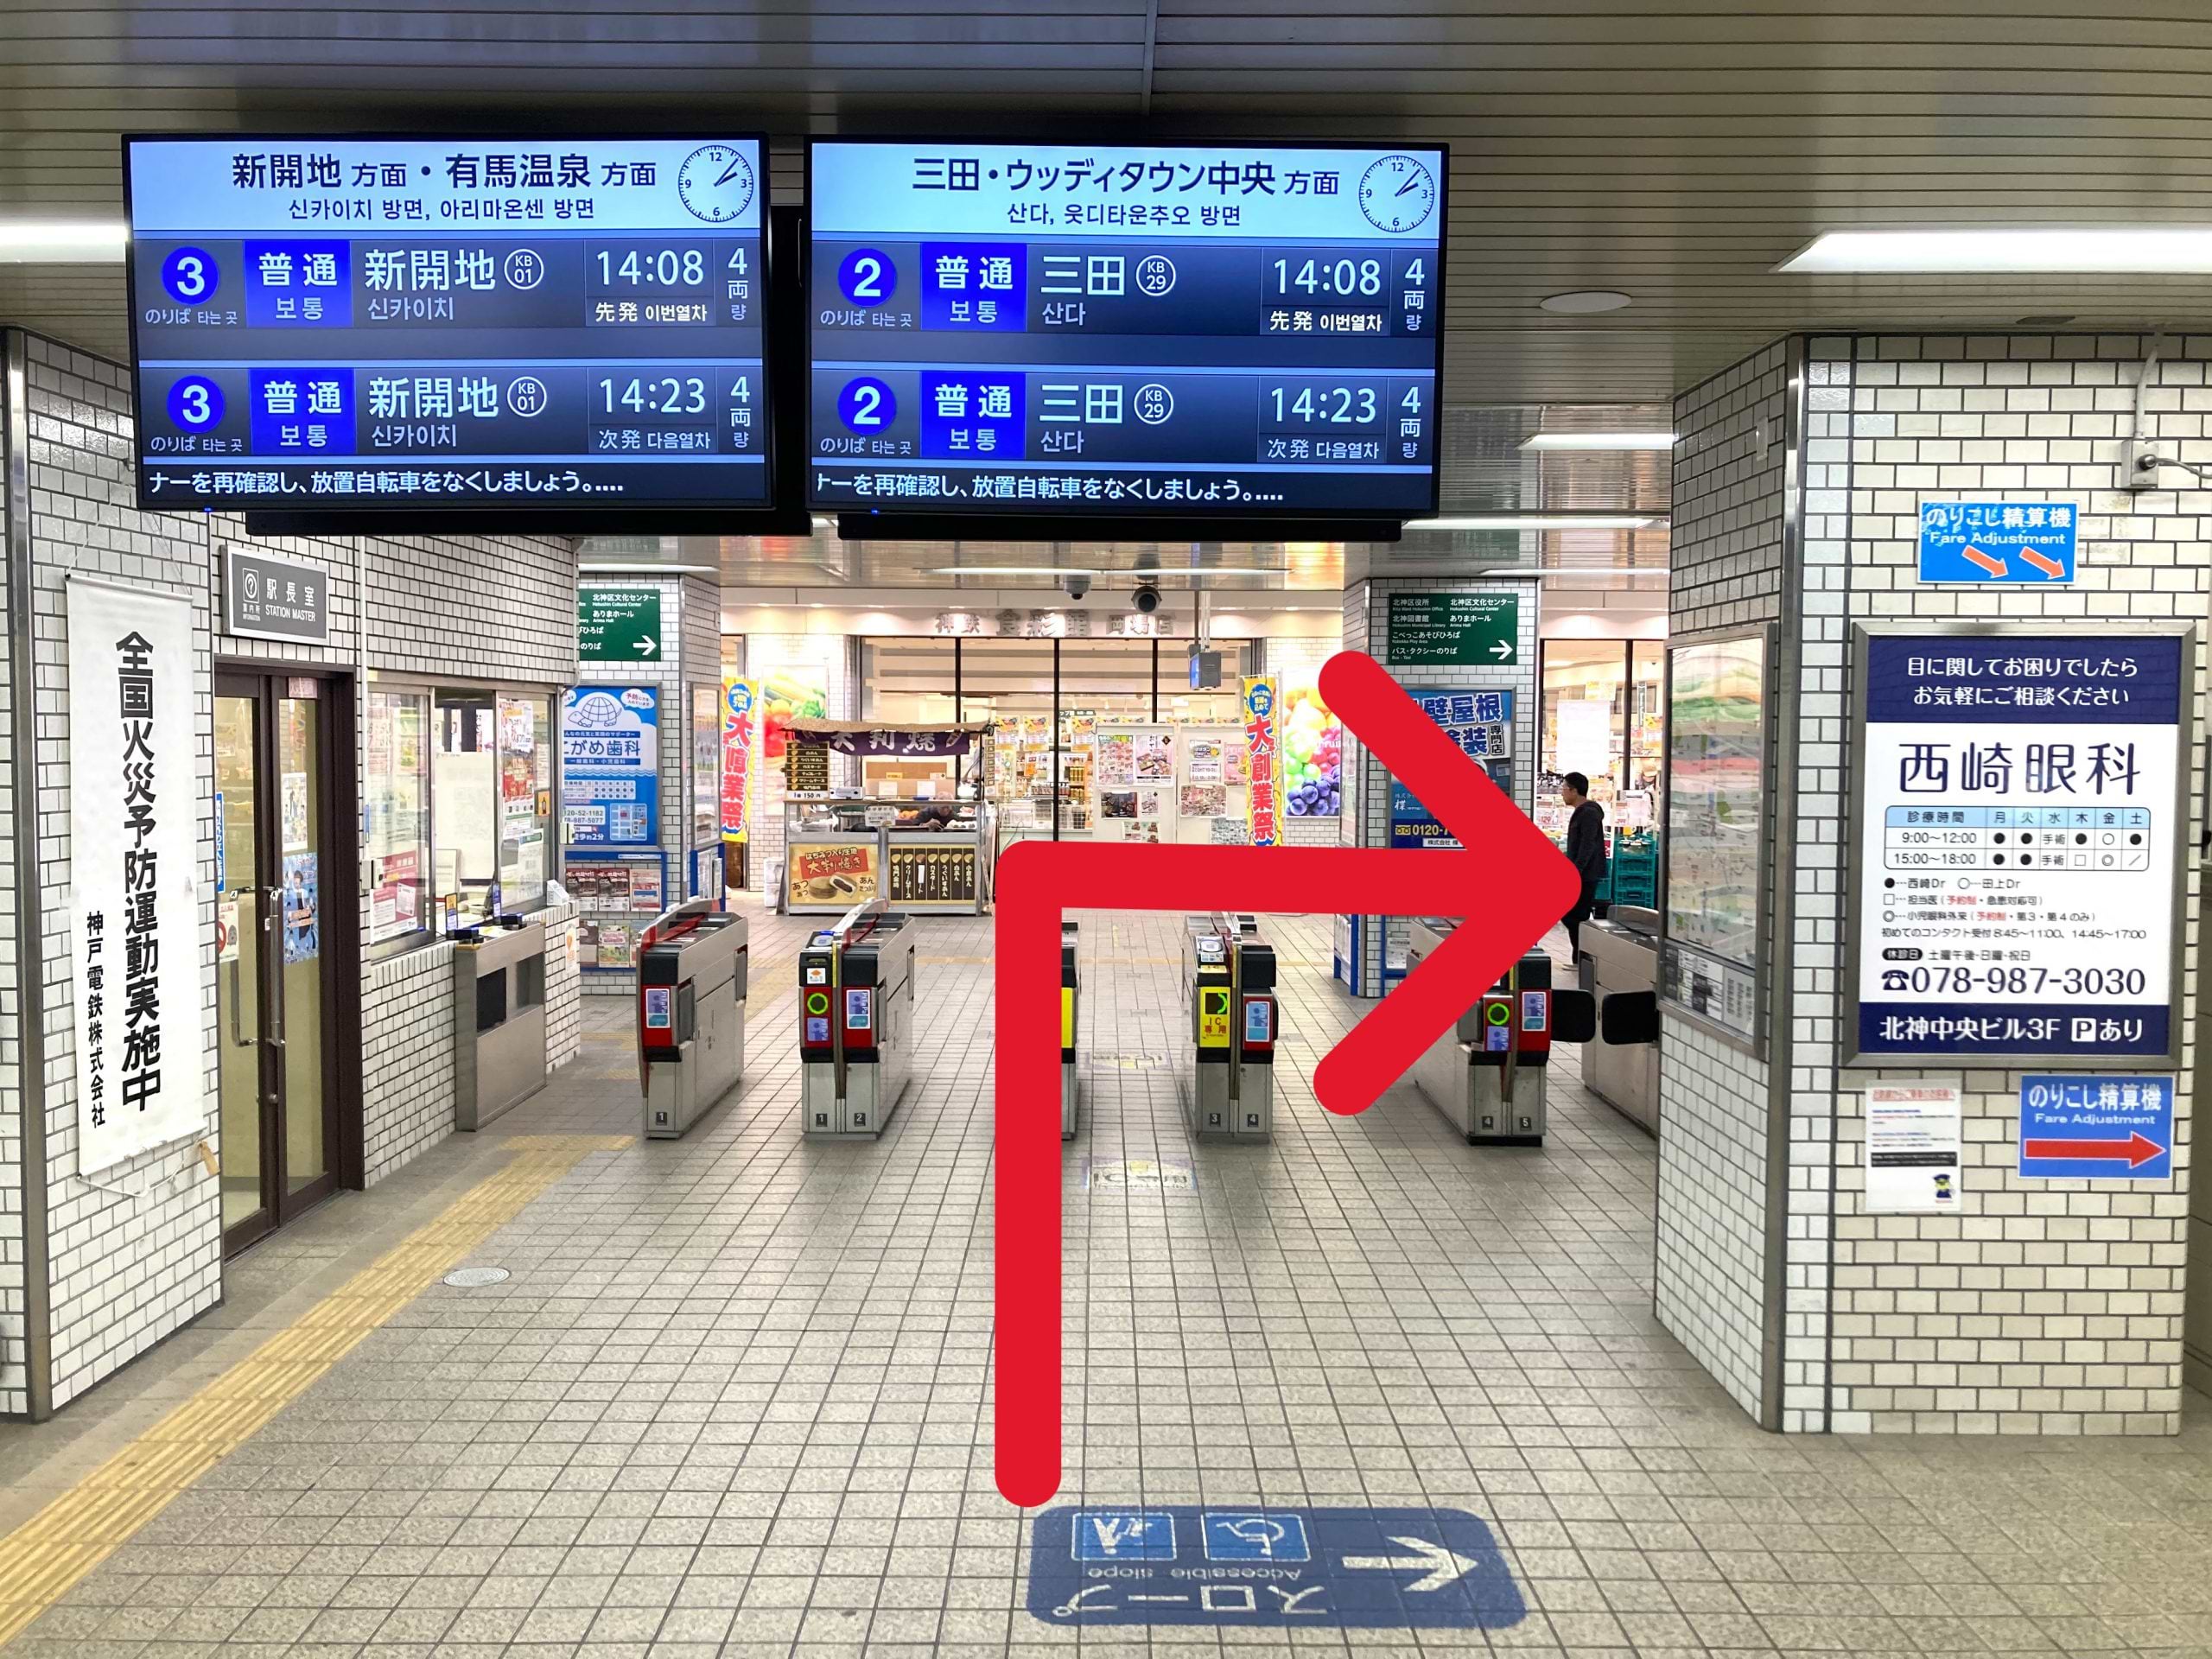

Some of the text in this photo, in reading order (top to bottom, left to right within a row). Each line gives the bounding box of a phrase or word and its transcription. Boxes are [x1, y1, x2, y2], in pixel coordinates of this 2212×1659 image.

[289, 199, 594, 222] 신카이치 방면, 아리마온센 방면
[1007, 204, 1242, 227] 산다, 웃디타운추오 방면
[257, 251, 339, 288] 普通
[365, 249, 497, 292] 新開地
[515, 255, 533, 267] KB
[595, 249, 704, 287] 14:08
[728, 247, 748, 273] 4
[1147, 261, 1165, 274] KB
[1405, 258, 1426, 283] 4
[176, 257, 207, 296] 3
[514, 268, 533, 283] 01
[853, 258, 882, 297] 2
[935, 256, 1014, 291] 普通
[1040, 255, 1126, 296] 三田
[1146, 276, 1167, 290] 29
[1273, 257, 1381, 296] 14:08
[728, 278, 749, 300] 両
[276, 296, 323, 321] 보통
[367, 296, 454, 321] 신카이치
[950, 299, 998, 324] 보통
[1403, 291, 1425, 310] 両
[145, 306, 238, 325] のりば 타는 곳
[594, 302, 707, 322] 先発 이번열차
[730, 303, 747, 321] 량
[820, 308, 912, 327] のりば 타는 곳
[1041, 302, 1086, 327] 산다
[1269, 310, 1382, 332] 先発 이번열차
[1405, 313, 1421, 332] 량
[263, 380, 342, 415] 普通
[369, 376, 499, 418] 新開地
[518, 381, 536, 394] KB
[599, 377, 707, 415] 14:23
[731, 376, 750, 403] 4
[1145, 390, 1163, 403] KB
[182, 383, 212, 424] 3
[517, 396, 537, 410] 01
[853, 385, 881, 425] 2
[934, 384, 1013, 419] 普通
[1039, 385, 1124, 423] 三田
[1270, 386, 1376, 423] 14:23
[1402, 386, 1421, 413] 4
[731, 407, 751, 428] 両
[1144, 404, 1165, 419] 29
[279, 424, 327, 448] 보통
[371, 423, 458, 448] 신카이치
[1400, 417, 1421, 437] 両
[150, 434, 243, 453] のりば 타는 곳
[598, 429, 711, 450] 次発 다음열차
[733, 431, 749, 449] 량
[820, 435, 912, 455] のりば 타는 곳
[949, 428, 997, 451] 보통
[1040, 430, 1084, 454] 산다
[1267, 438, 1380, 460] 次発 다음열차
[1402, 441, 1418, 459] 량
[1925, 506, 2072, 529] のりこし精算機
[1929, 531, 2066, 546] Fare Adjustment
[266, 577, 315, 607] 駅長室
[1450, 598, 1515, 607] 北神区文化センター
[265, 604, 315, 622] STATION MASTER
[1392, 631, 1461, 639] こべっこあそびひろば
[1907, 657, 2139, 677] 目に関してお困りでしたら
[1913, 686, 2130, 707] お気軽にご相談ください
[1490, 725, 1504, 756] 専門店
[1245, 713, 1275, 842] 大創業祭
[1898, 741, 2141, 796] 西崎眼科
[1907, 810, 1965, 823] 診療時間
[1993, 812, 2006, 823] 月
[2021, 812, 2034, 823] 火
[2048, 812, 2061, 823] 水
[2075, 812, 2089, 823] 木
[2102, 812, 2115, 824] 金
[2130, 814, 2143, 824] 土
[2043, 834, 2065, 846] 手術
[116, 631, 162, 1112] 全国火災予防運動実施中
[2042, 855, 2064, 866] 手術
[1911, 966, 2145, 995] 078-987-3030
[86, 912, 105, 1129] 神戸電鉄株式会社
[1879, 1016, 2062, 1041] 北神中央ビル3F
[2029, 1084, 2162, 1111] のりこし精算機
[2035, 1114, 2156, 1126] Fare Adjustment
[1170, 1567, 1301, 1580] Accessible
[1052, 1584, 1328, 1618] スロープ
